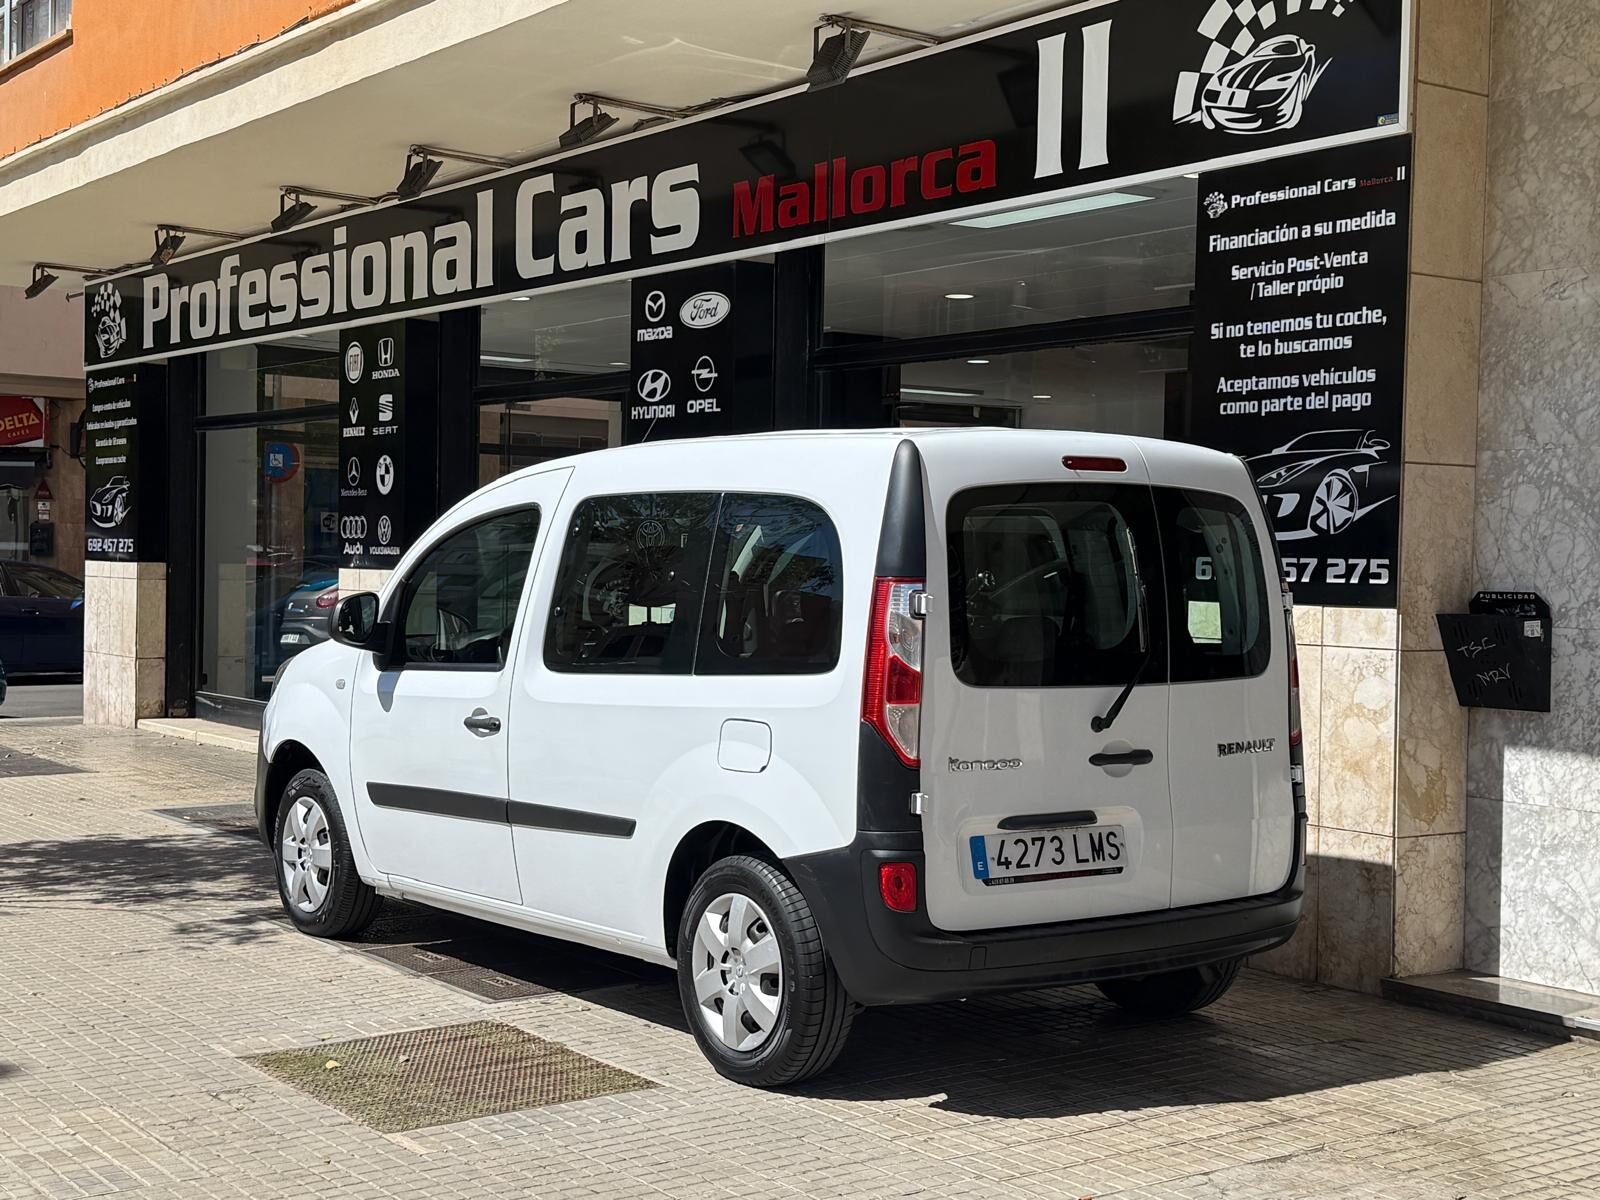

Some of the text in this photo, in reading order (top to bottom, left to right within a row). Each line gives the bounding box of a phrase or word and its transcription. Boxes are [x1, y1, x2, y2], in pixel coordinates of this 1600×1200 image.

[142, 19, 1112, 349] Professional Cars Mallorca II
[1231, 181, 1321, 208] Professional
[1324, 178, 1356, 193] Cars
[1359, 176, 1393, 187] Mallorca
[1209, 209, 1396, 252] Financiación a su medida
[1231, 251, 1368, 280] Servicio Post-Venta
[1257, 280, 1295, 298] Taller
[1297, 274, 1344, 296] própio
[690, 298, 720, 321] Ford
[1211, 306, 1387, 339] Si no tenemos tu coche,
[1240, 335, 1353, 358] te lo buscamos
[372, 368, 400, 380] HONDA
[1217, 367, 1376, 395] Aceptamos vehículos
[631, 404, 675, 420] HYUNDAI
[687, 398, 721, 413] OPEL
[1220, 391, 1371, 417] como parte del pago
[372, 425, 399, 436] SEAT
[88, 538, 134, 552] 692 457 275
[343, 542, 364, 555] Audi
[1326, 558, 1390, 585] 275
[1217, 738, 1275, 757] RENAULT
[977, 831, 1121, 871] E 4273 LMS
